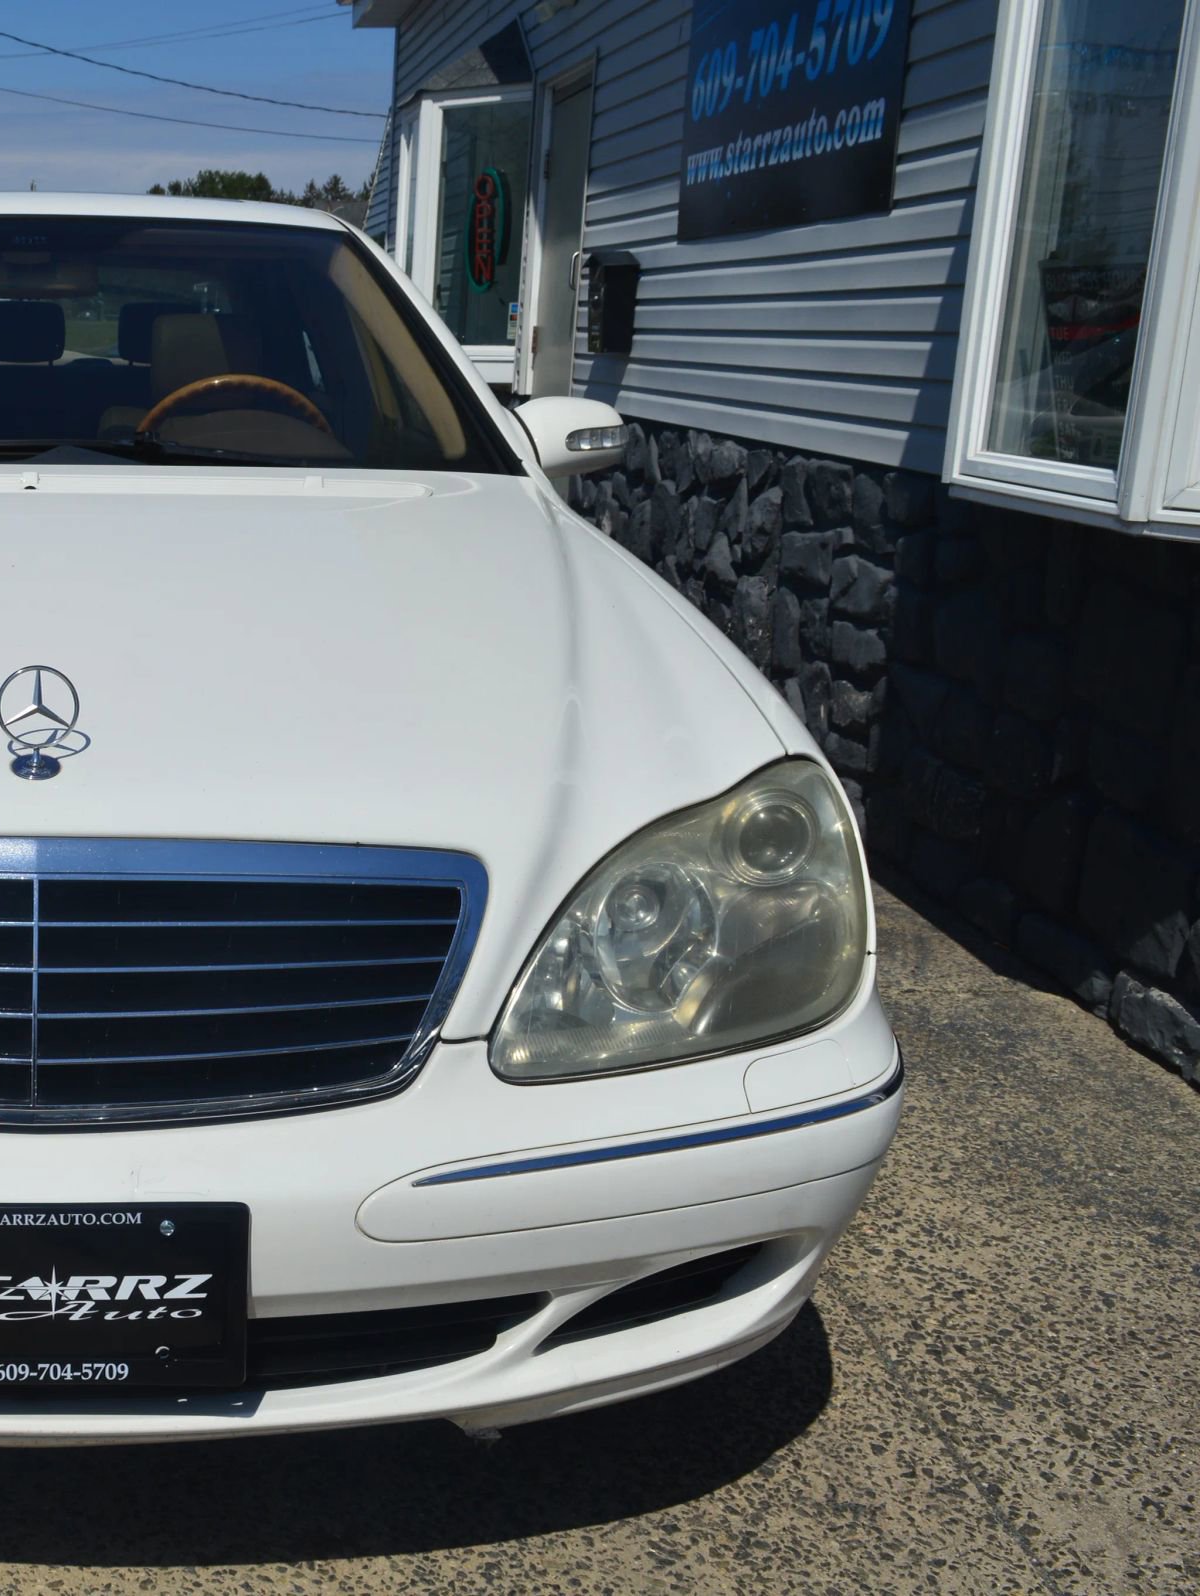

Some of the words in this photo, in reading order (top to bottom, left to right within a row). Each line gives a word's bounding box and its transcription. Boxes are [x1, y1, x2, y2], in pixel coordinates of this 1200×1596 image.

[692, 0, 894, 122] 609-704-5709
[687, 97, 885, 185] www.starrzauto.com
[474, 175, 495, 281] OPEN
